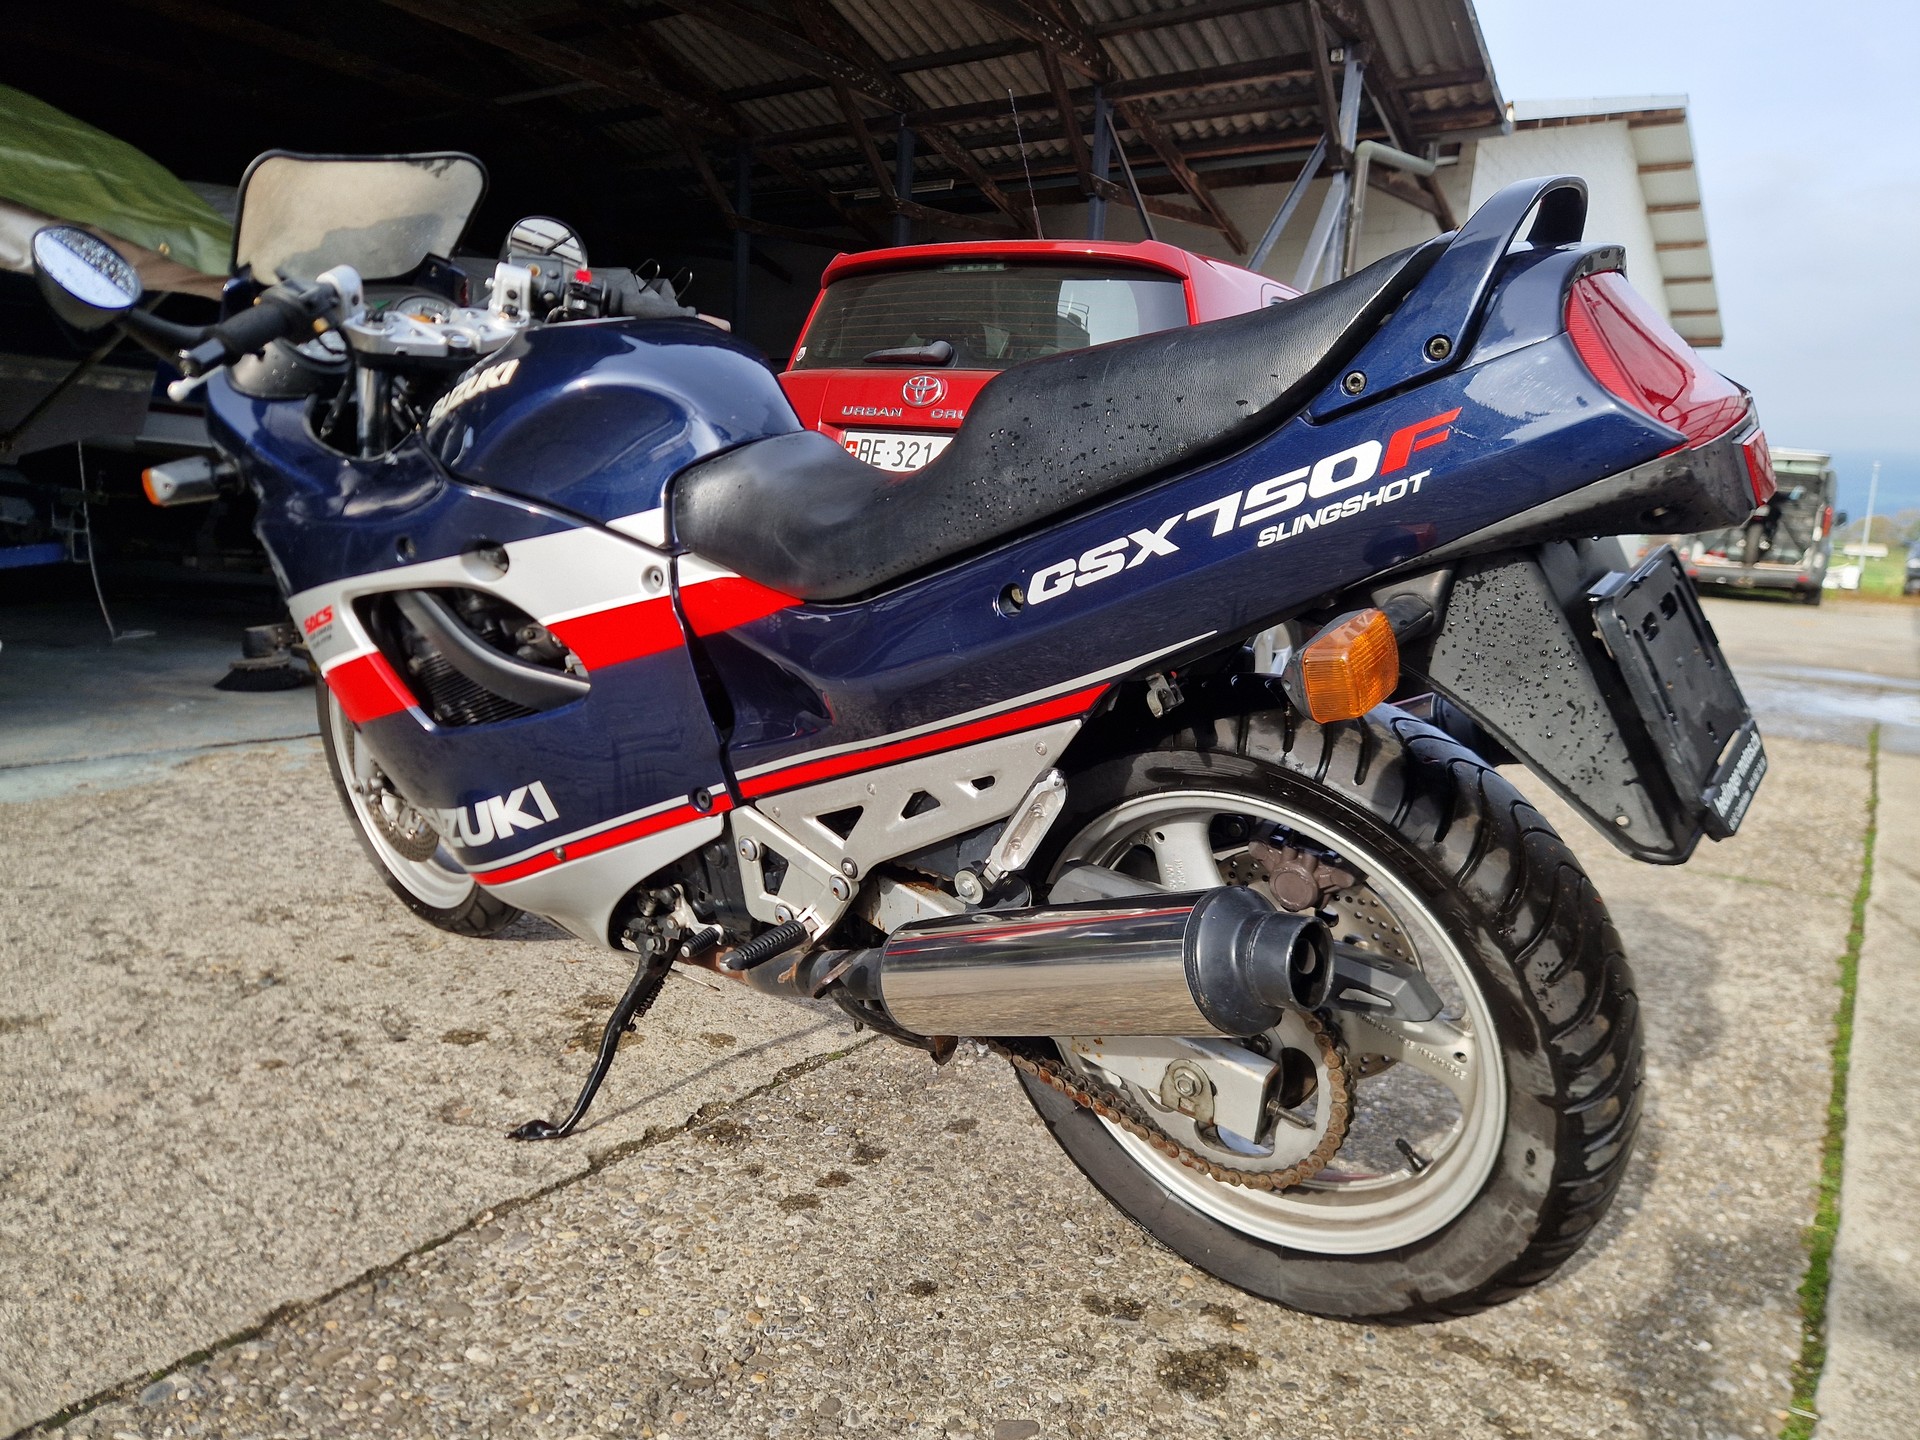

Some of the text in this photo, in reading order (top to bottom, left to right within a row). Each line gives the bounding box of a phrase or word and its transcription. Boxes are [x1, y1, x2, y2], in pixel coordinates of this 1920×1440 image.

[841, 405, 903, 417] URBAN
[1257, 470, 1431, 549] SLINGSHOT
[304, 604, 334, 634] SACS
[429, 780, 560, 848] ZUKI
